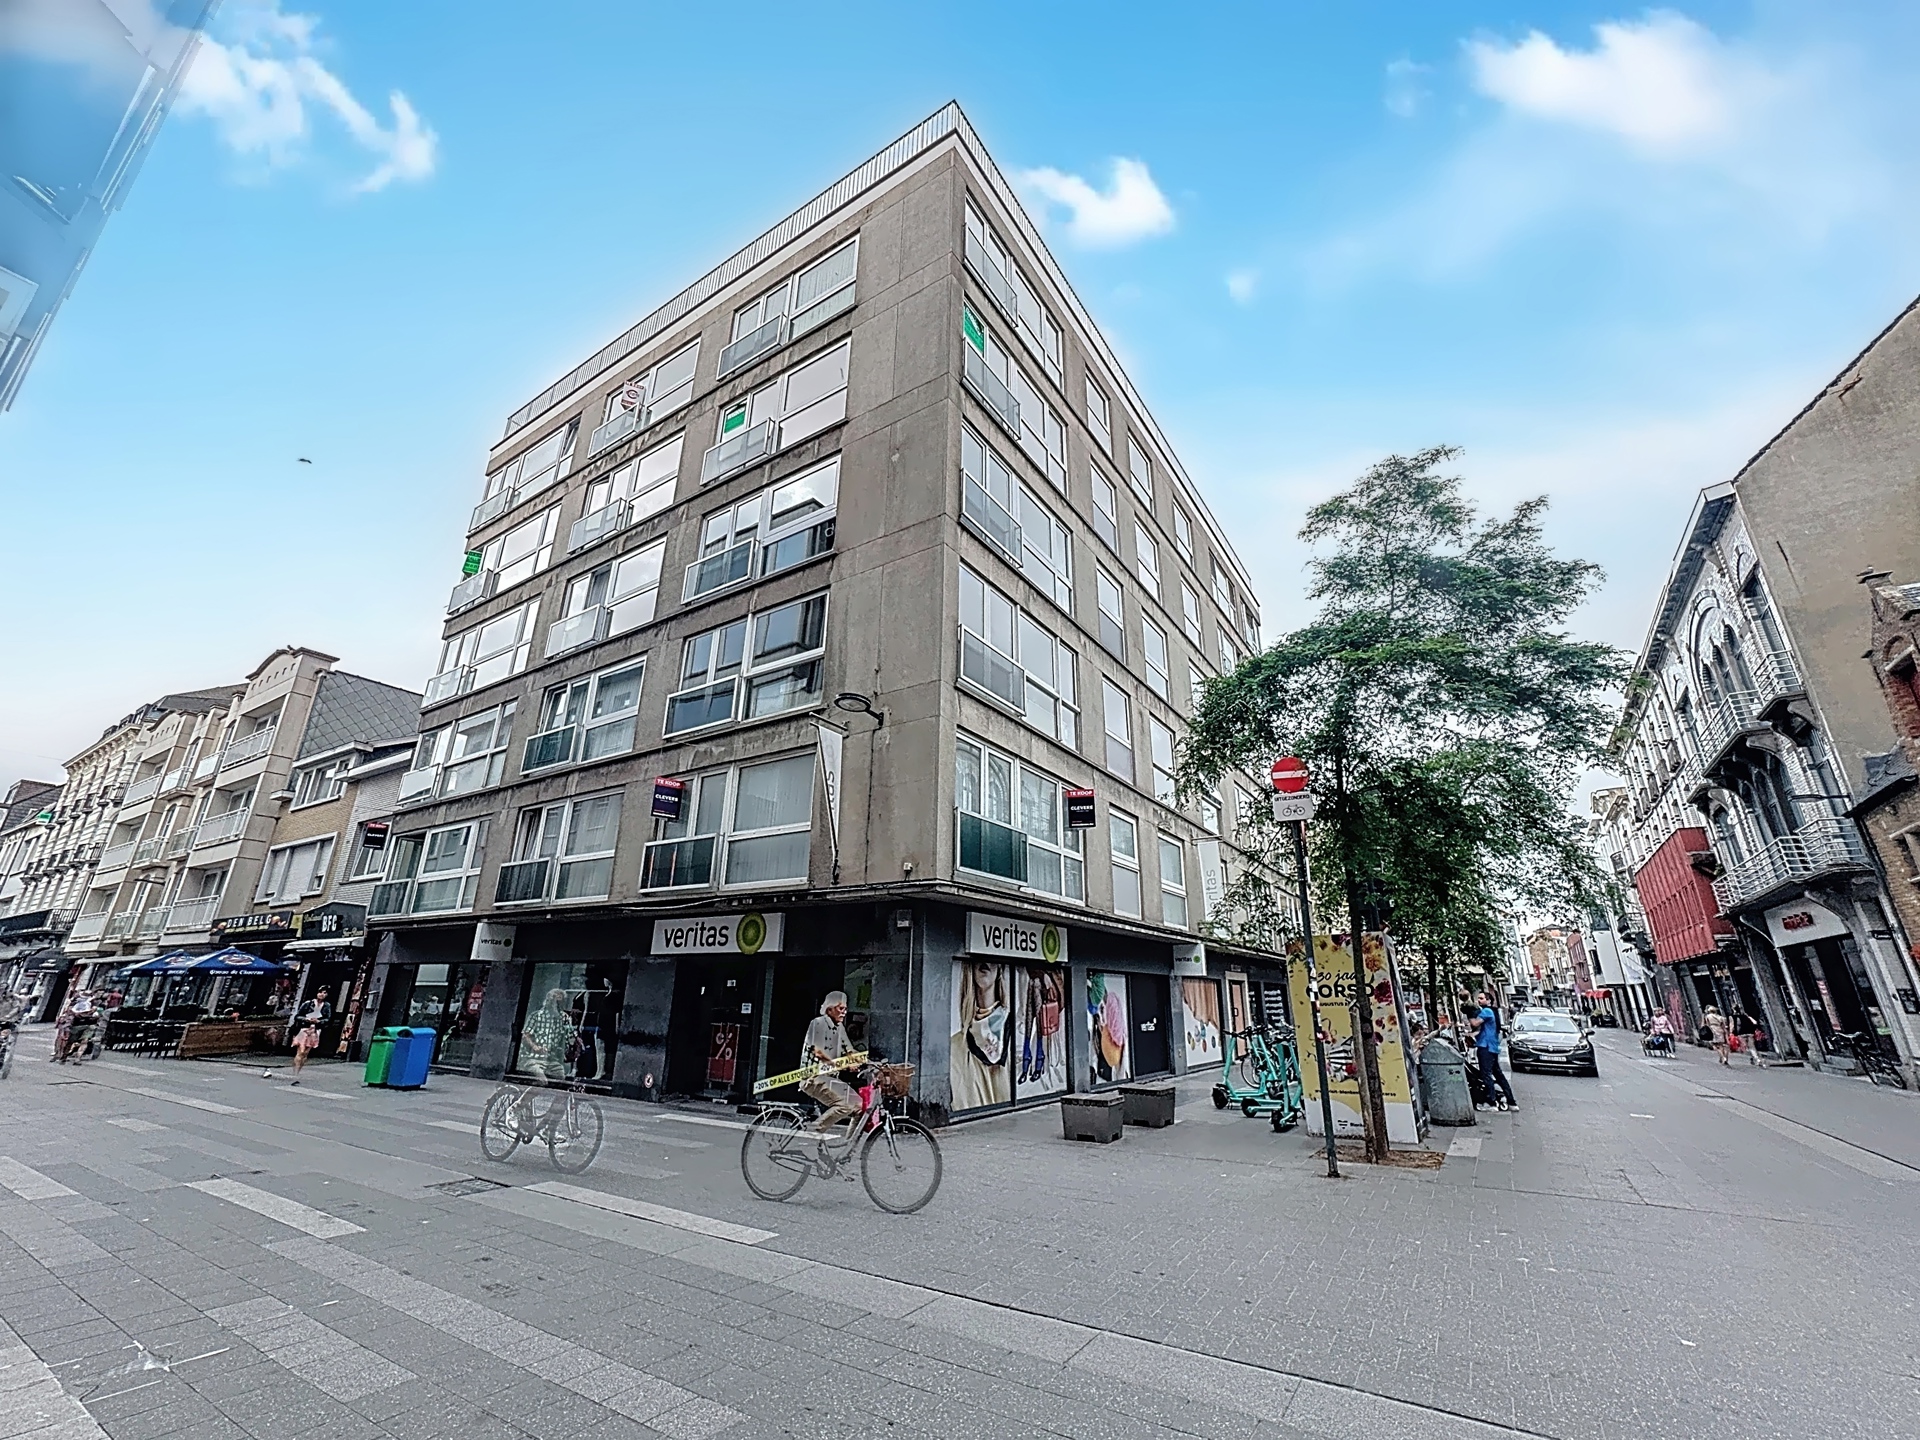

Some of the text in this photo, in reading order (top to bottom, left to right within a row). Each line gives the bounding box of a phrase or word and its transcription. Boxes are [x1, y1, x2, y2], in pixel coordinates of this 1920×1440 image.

[226, 917, 244, 929] DEN
[664, 921, 730, 948] veritas
[982, 923, 1038, 952] veritas
[769, 1078, 777, 1087] OP
[777, 1074, 790, 1084] ALLE
